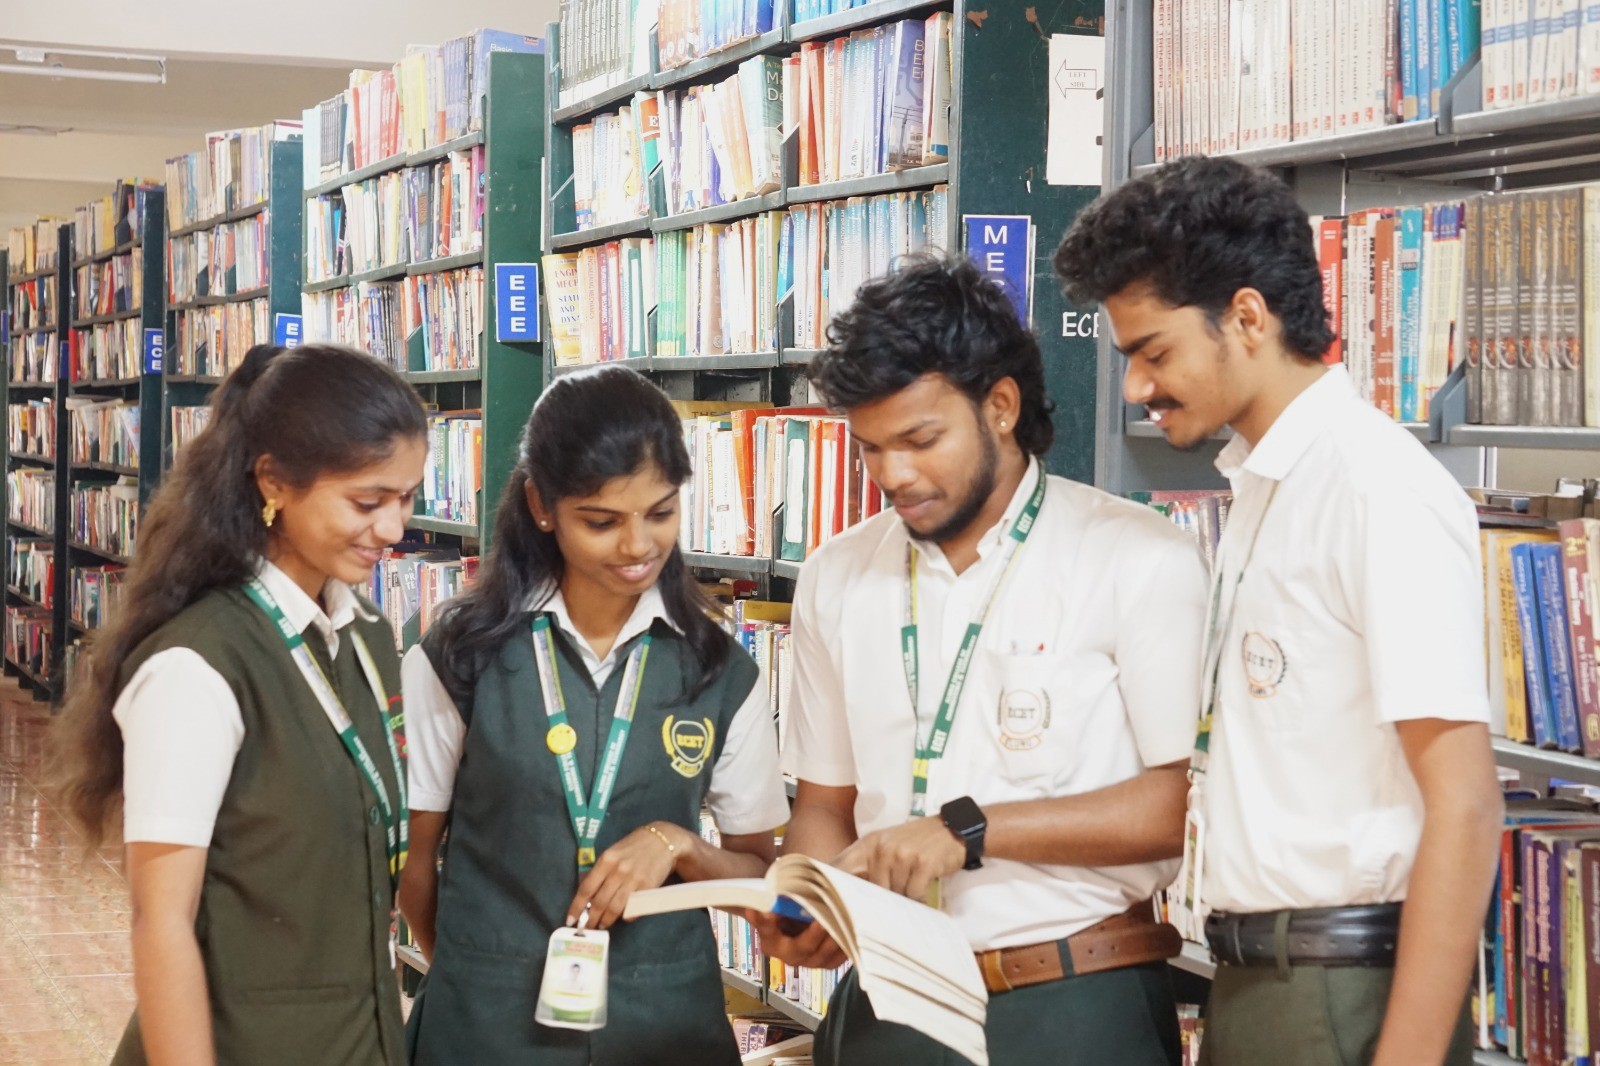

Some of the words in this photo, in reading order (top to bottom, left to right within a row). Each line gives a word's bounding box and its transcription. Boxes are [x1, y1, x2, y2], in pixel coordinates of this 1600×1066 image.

[1402, 18, 1410, 51] Graph
[1448, 6, 1460, 41] Graph
[1403, 53, 1411, 88] Theory
[1369, 237, 1377, 295] MEMS
[509, 274, 527, 333] EEE
[560, 304, 575, 313] AND
[1380, 259, 1390, 337] Thermodynamics
[151, 335, 163, 371] ECE
